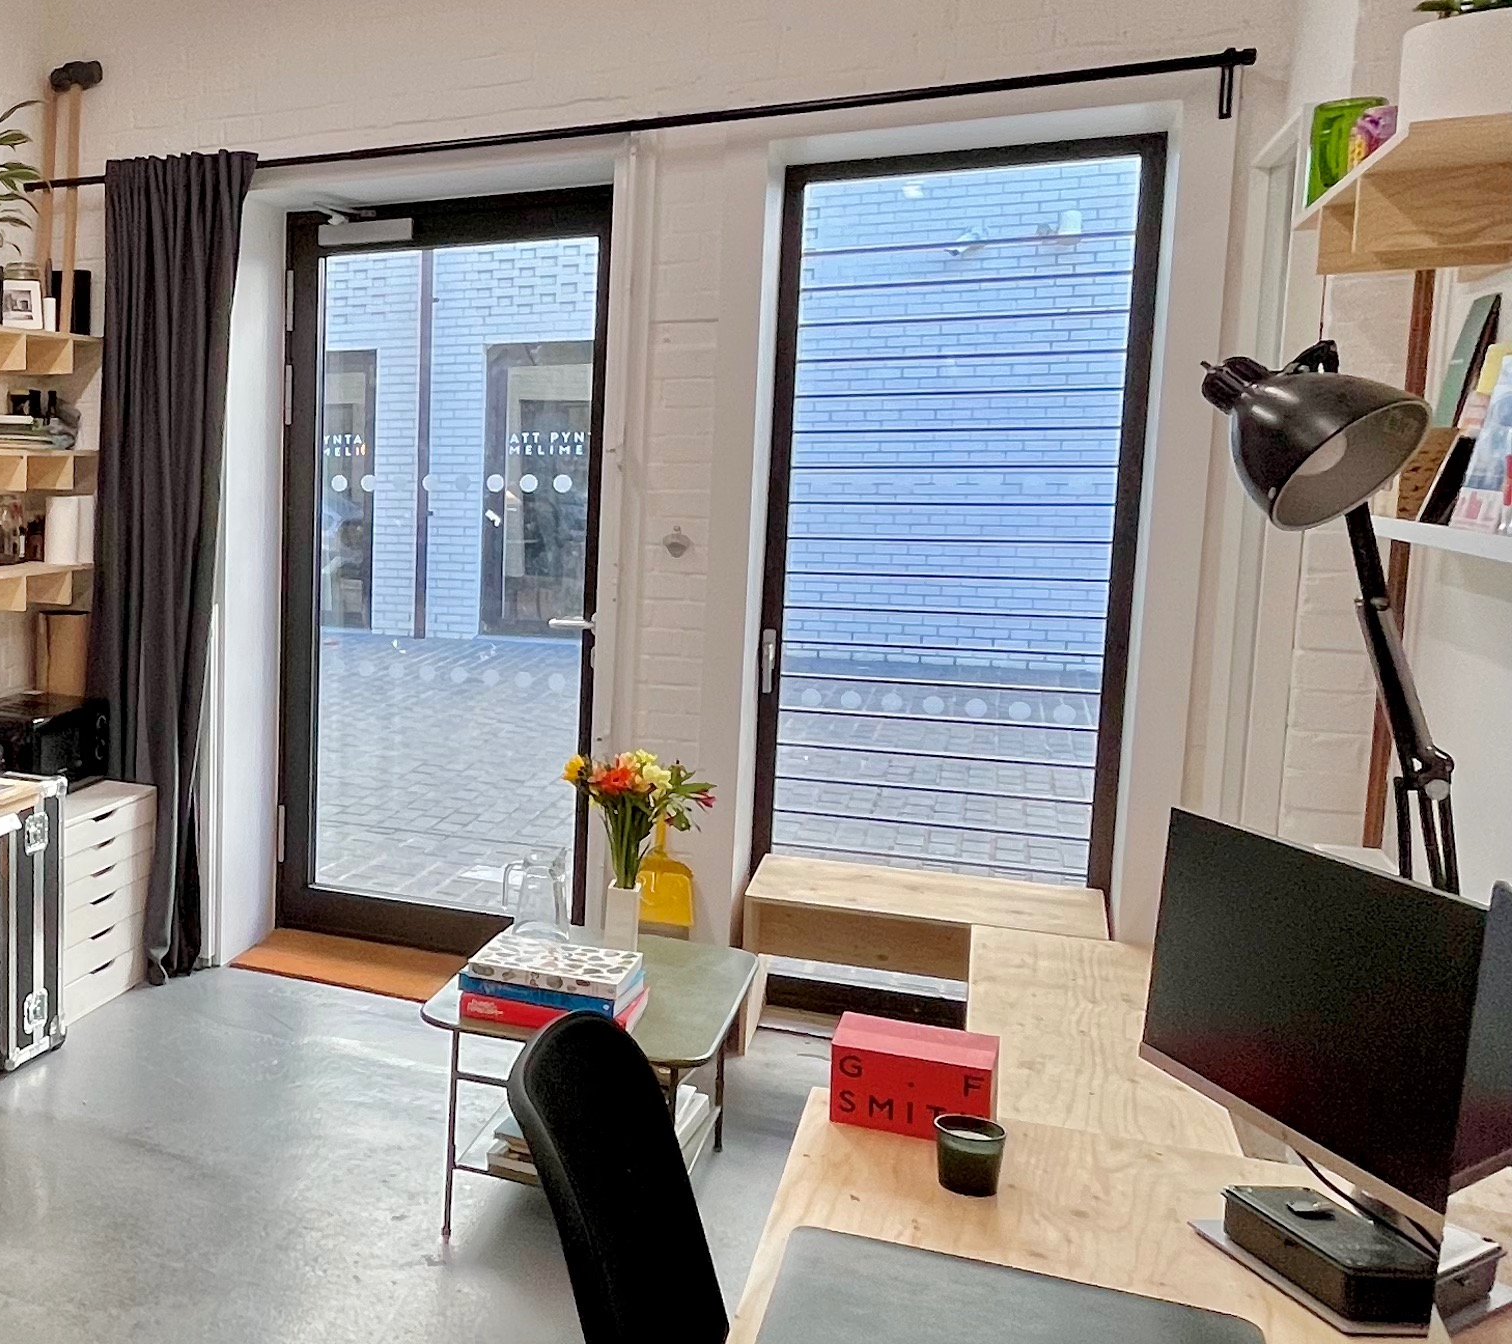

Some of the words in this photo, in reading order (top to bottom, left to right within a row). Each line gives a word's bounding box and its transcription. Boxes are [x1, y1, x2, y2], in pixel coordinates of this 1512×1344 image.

[509, 431, 540, 444] ATT
[550, 430, 591, 444] PYN
[509, 445, 584, 455] MELIME
[839, 1055, 862, 1078] G
[963, 1075, 985, 1097] F
[839, 1090, 988, 1131] SMIT
